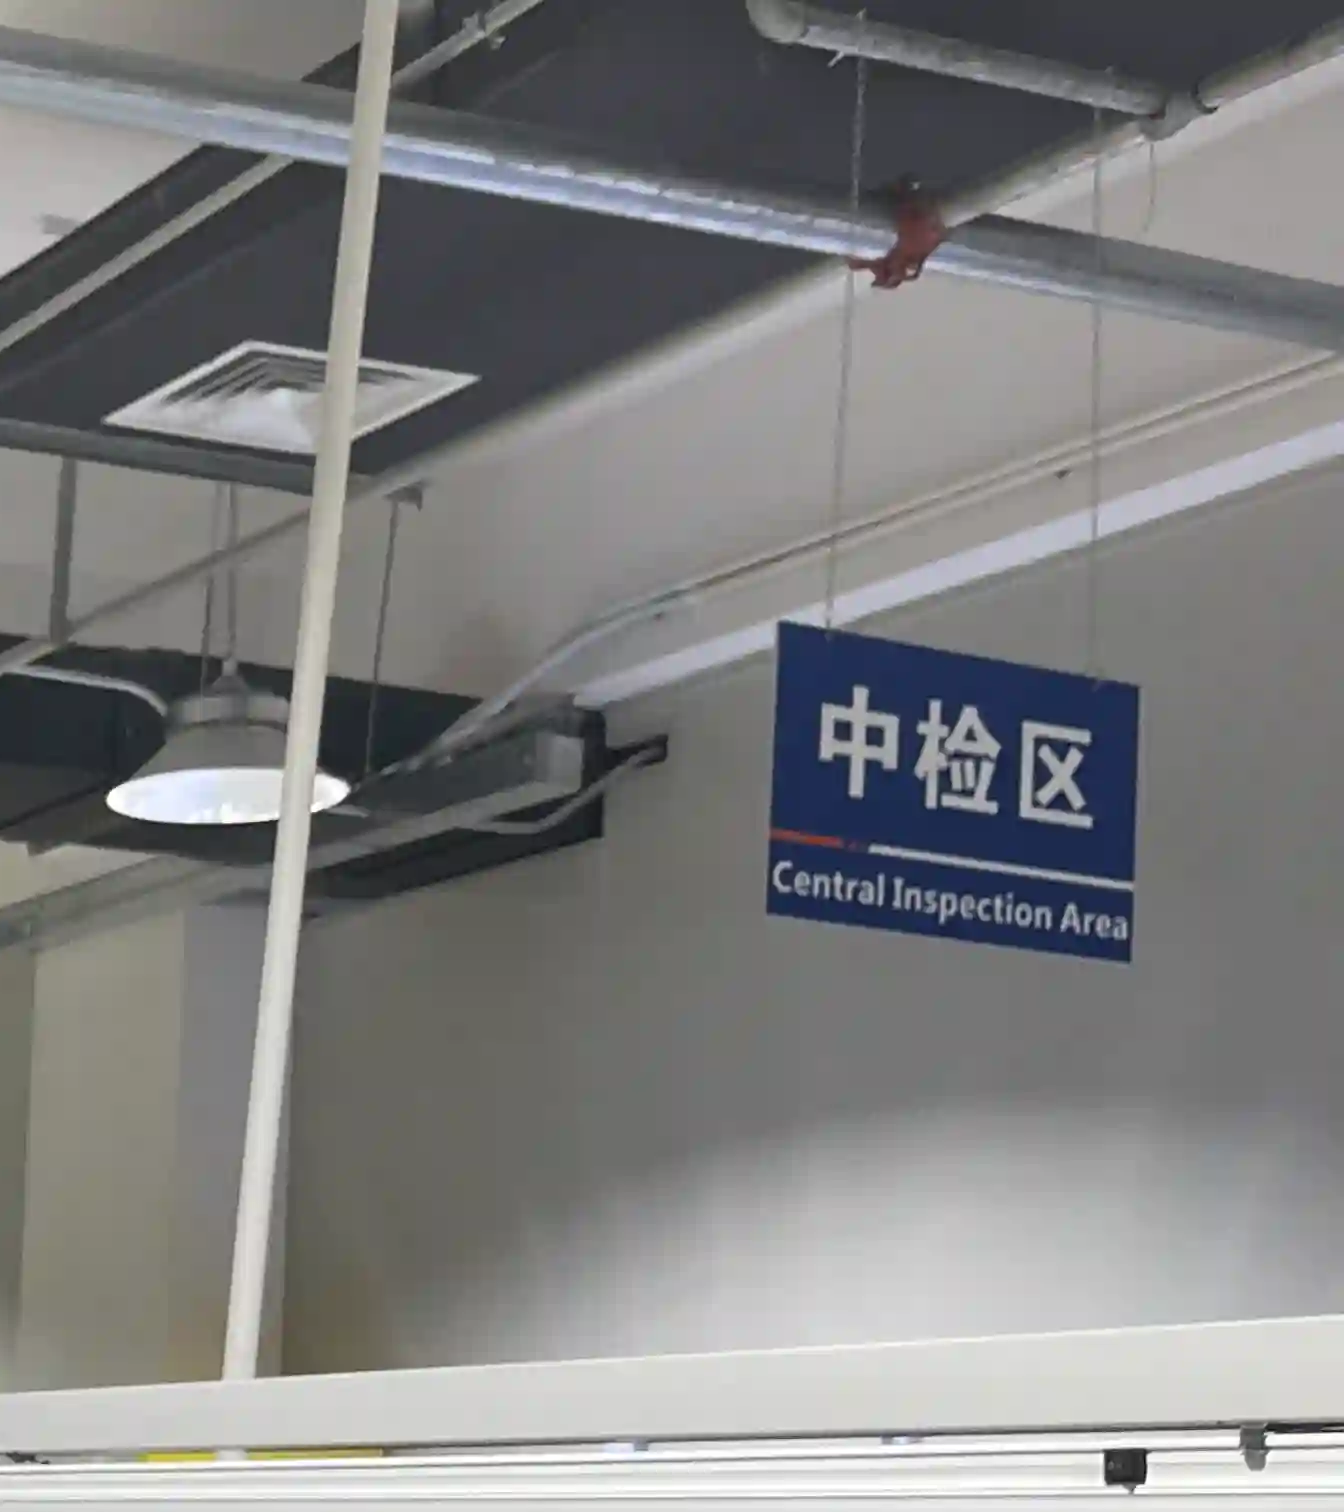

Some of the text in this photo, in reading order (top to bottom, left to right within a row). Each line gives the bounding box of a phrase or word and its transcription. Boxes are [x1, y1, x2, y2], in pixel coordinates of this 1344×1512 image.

[819, 684, 1093, 829] 中检区
[772, 861, 1128, 941] Central Inspection Area
